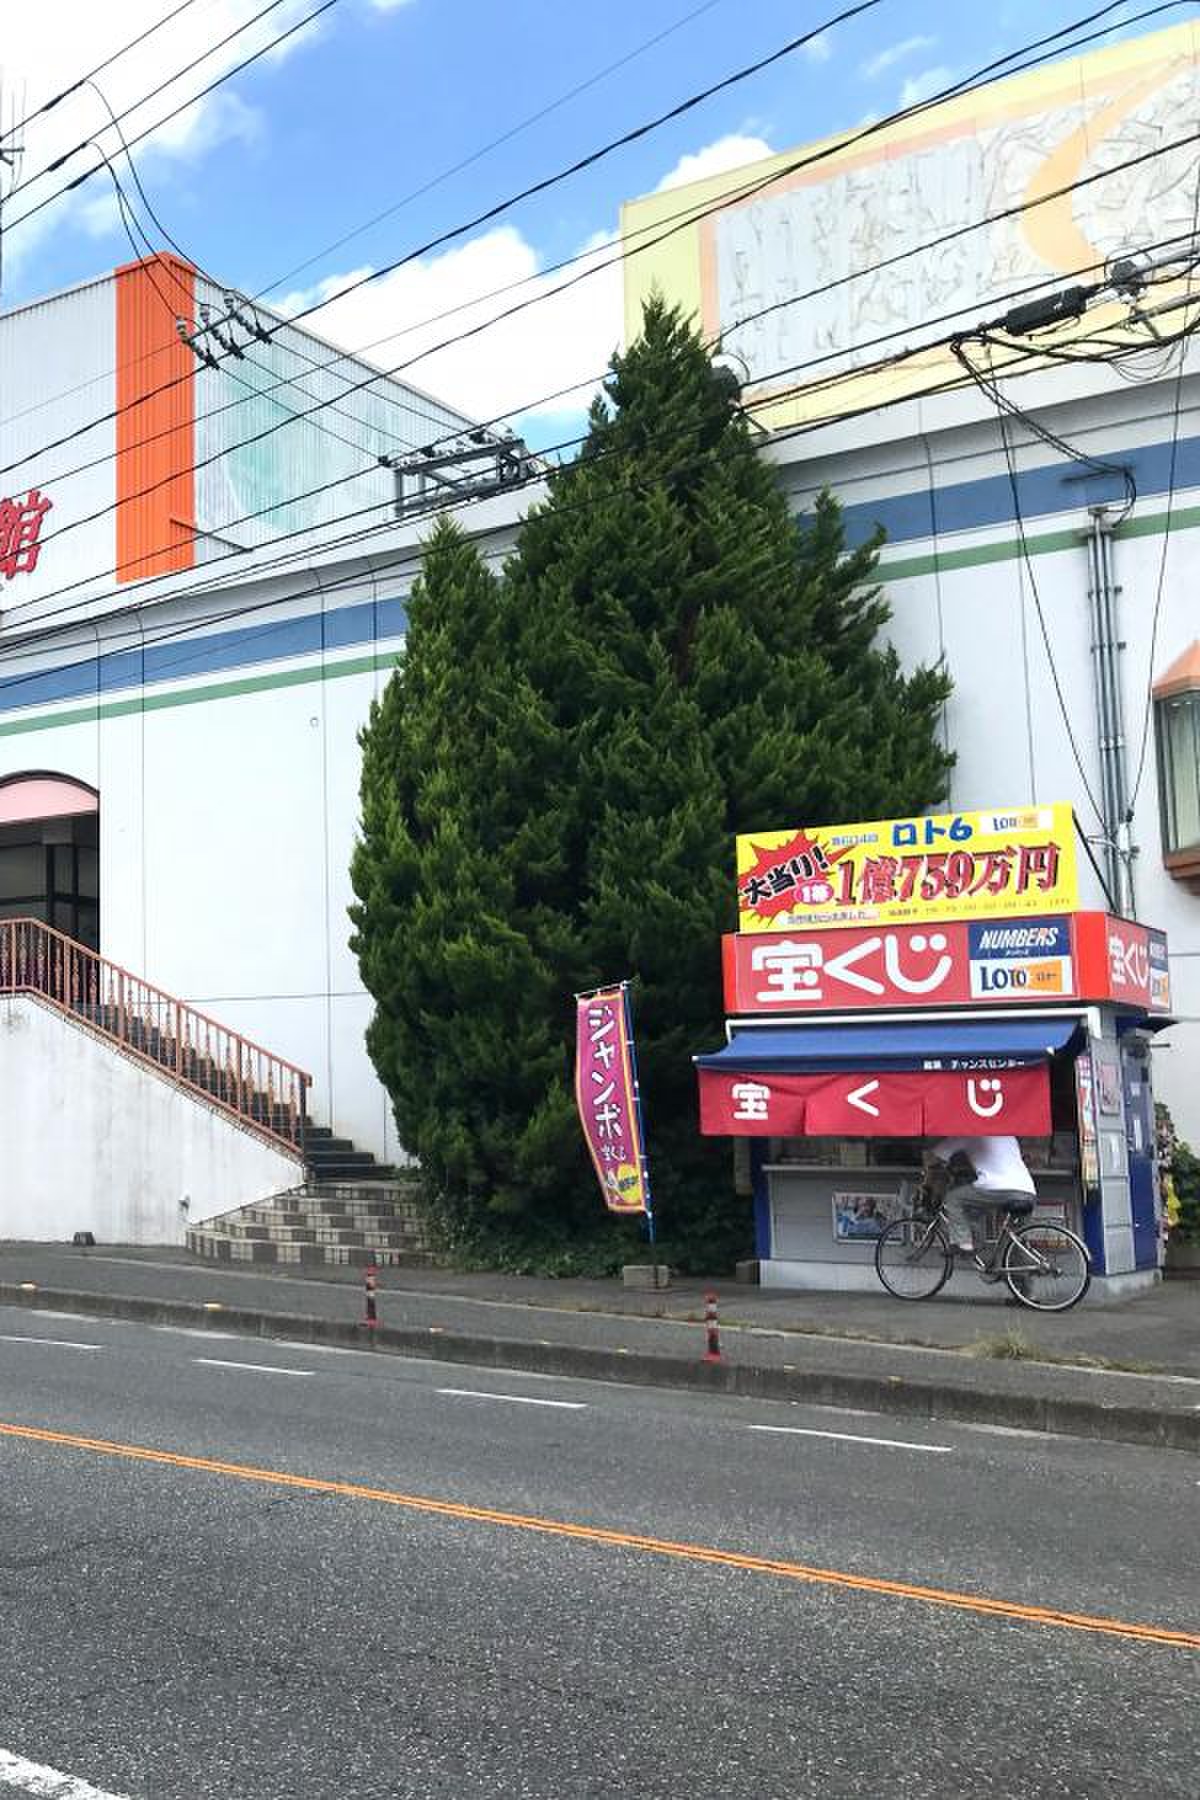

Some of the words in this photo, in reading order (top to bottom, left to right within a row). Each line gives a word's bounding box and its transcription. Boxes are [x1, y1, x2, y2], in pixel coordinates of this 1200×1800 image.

[891, 817, 973, 847] ロト6
[979, 926, 1060, 950] NUMBERS
[752, 932, 952, 1002] 宝くじ
[979, 965, 1027, 992] LOTO
[1108, 935, 1150, 989] 宝くじ
[588, 1006, 624, 1138] ジャンボ
[732, 1079, 1004, 1120] 宝くじ
